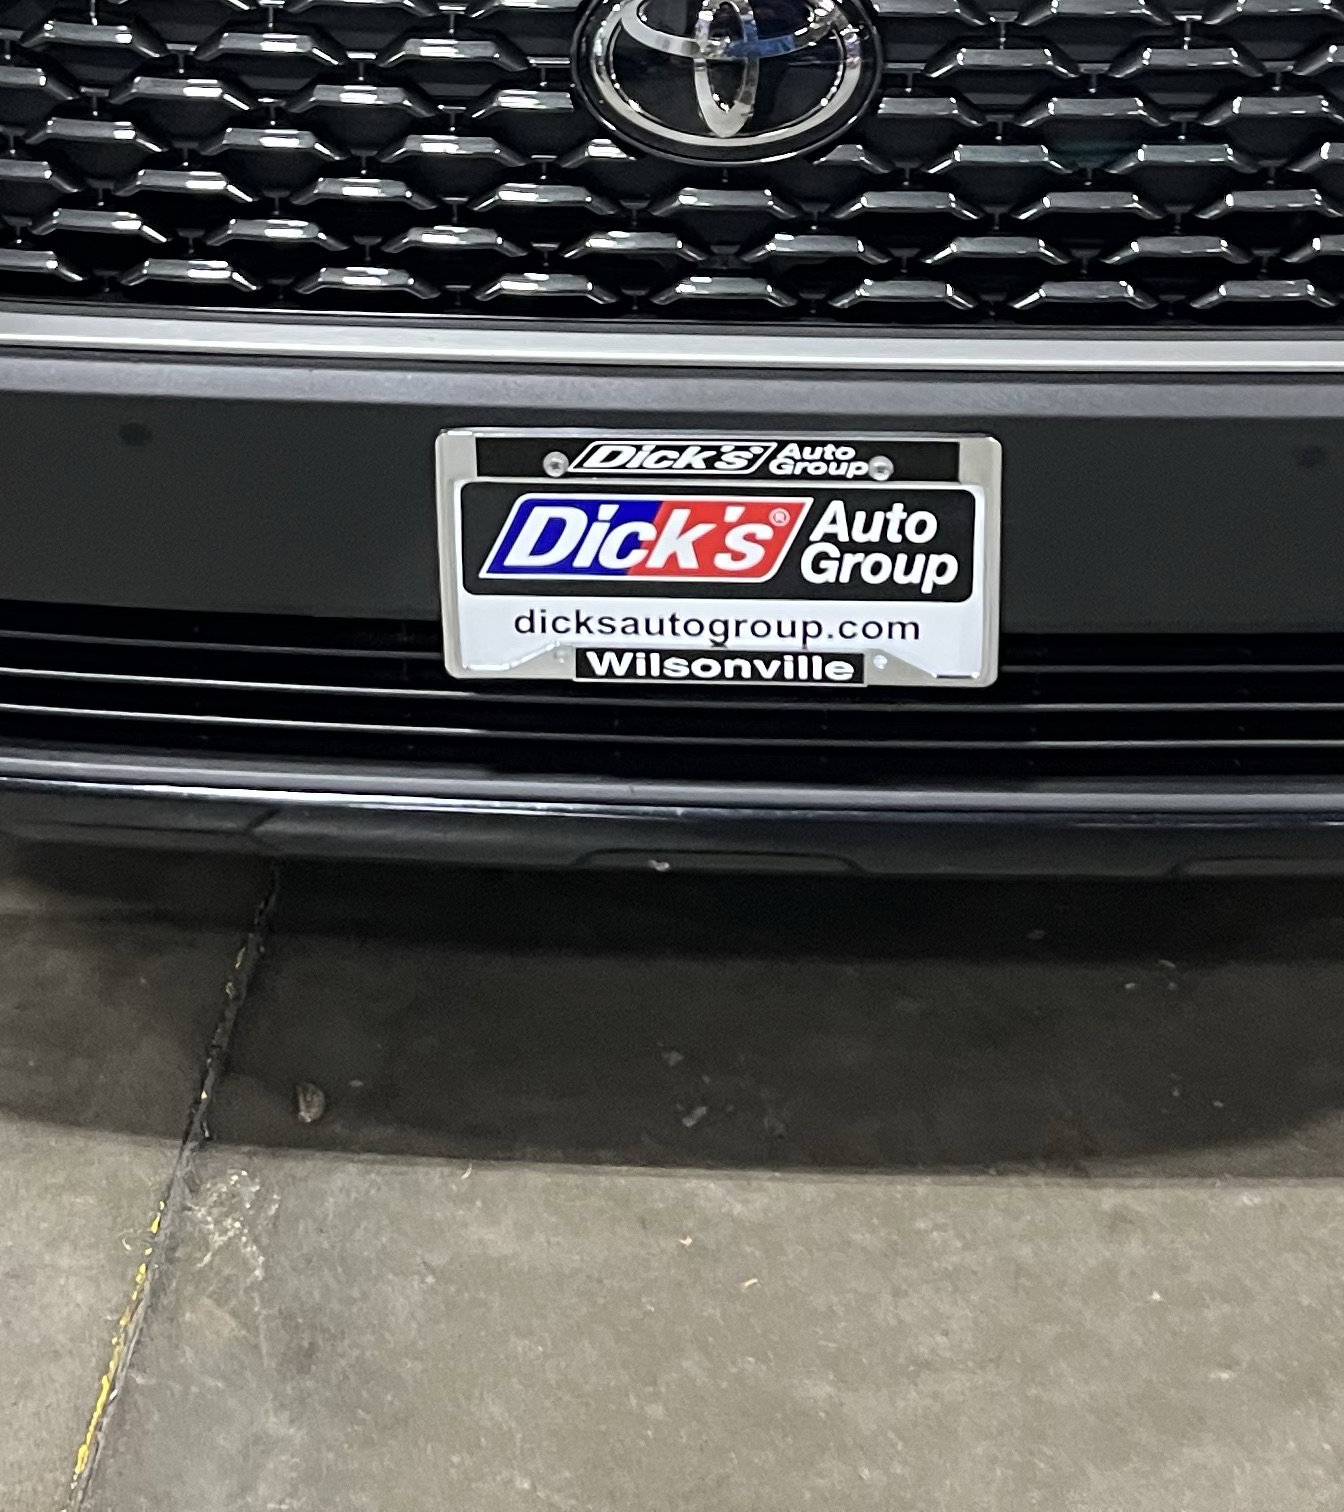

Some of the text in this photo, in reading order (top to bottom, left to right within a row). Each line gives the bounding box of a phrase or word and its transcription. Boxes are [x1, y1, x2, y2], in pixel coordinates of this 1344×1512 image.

[768, 458, 870, 479] Group
[775, 442, 857, 461] Auto
[809, 499, 938, 544] Auto
[800, 542, 959, 595] Group
[513, 608, 922, 648] dicksautogroup.com
[585, 650, 856, 682] Wilsonville
